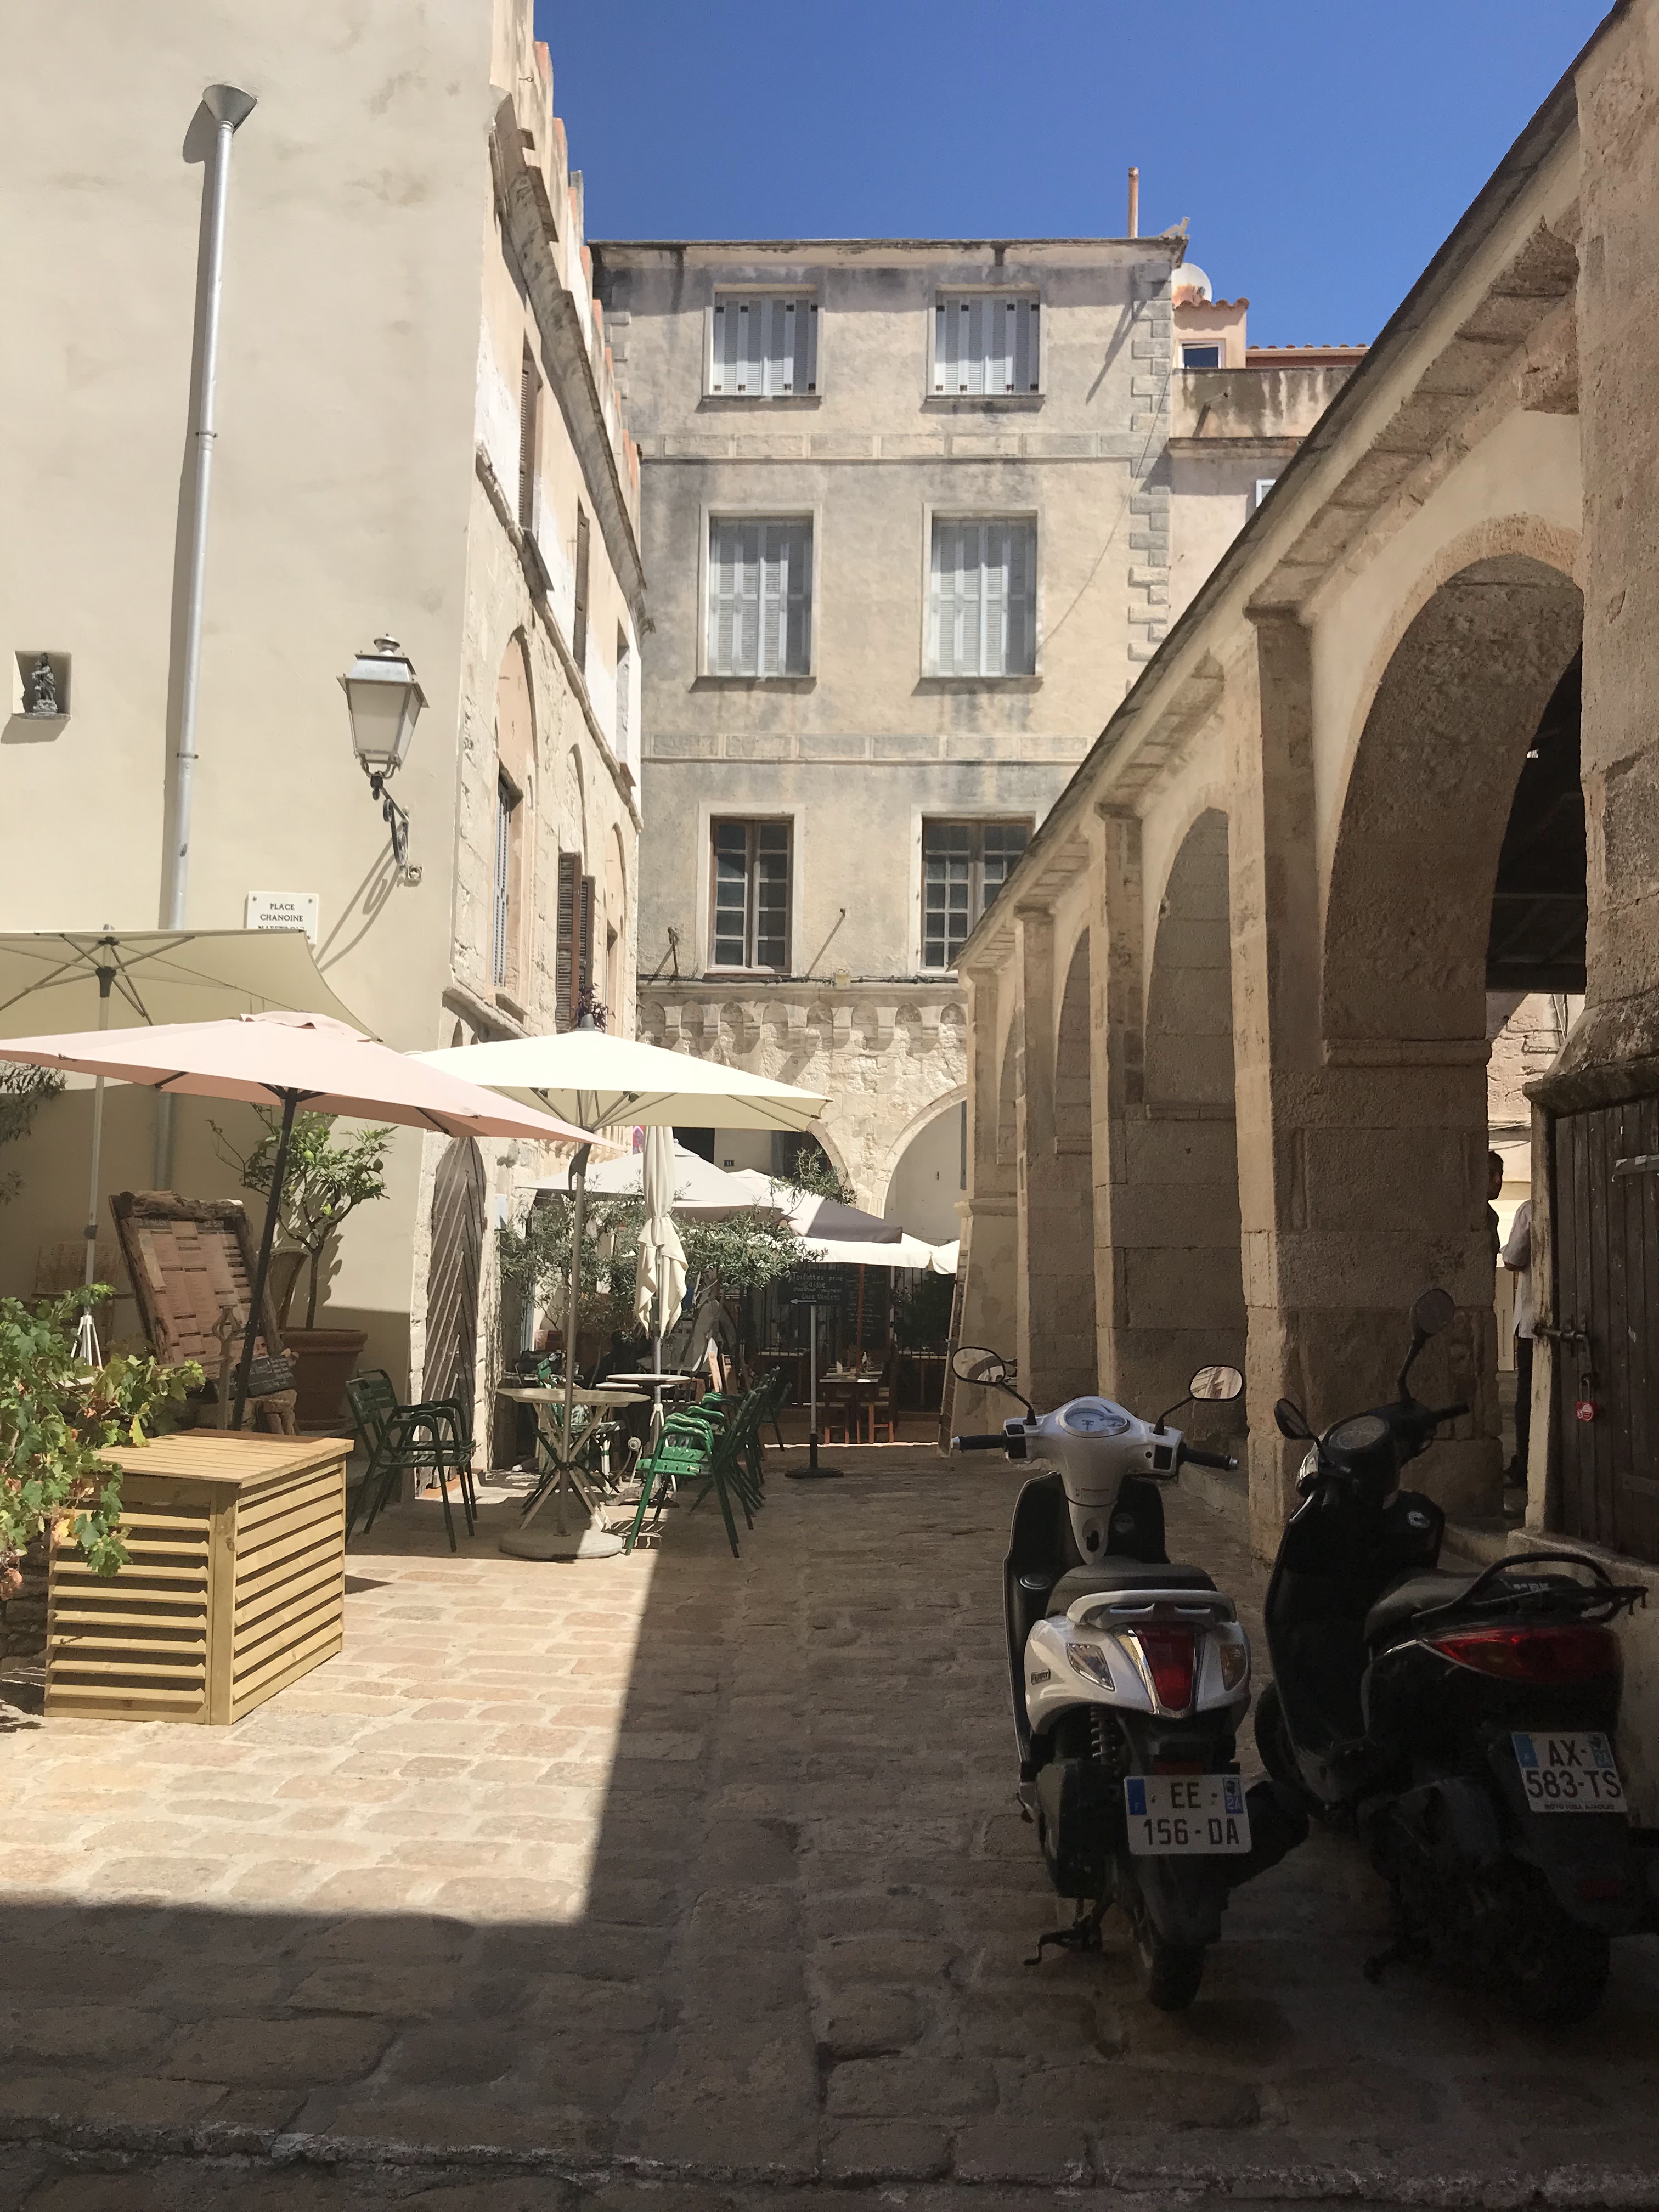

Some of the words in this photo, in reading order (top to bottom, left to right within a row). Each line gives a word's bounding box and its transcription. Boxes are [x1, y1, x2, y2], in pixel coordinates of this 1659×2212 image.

[1526, 1770, 1621, 1798] 583-TS
[1227, 1798, 1240, 1809] 2A
[1144, 1818, 1239, 1844] 156-DA
